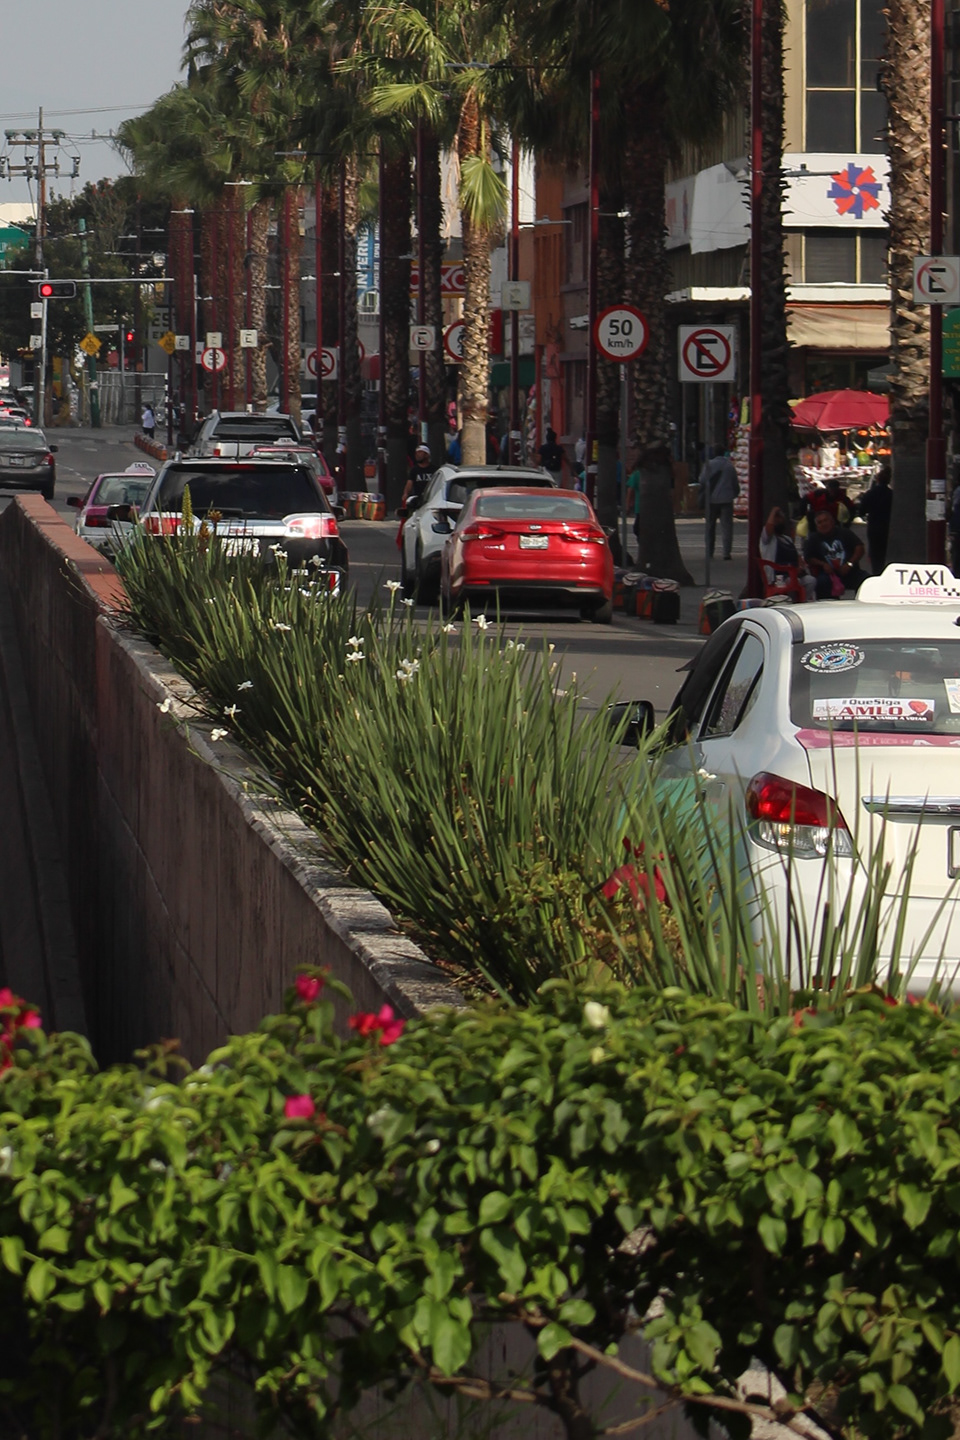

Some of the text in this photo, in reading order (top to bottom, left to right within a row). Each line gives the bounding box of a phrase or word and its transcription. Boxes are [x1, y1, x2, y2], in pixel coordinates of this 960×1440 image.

[609, 319, 633, 336] 50
[607, 338, 634, 348] km/h
[895, 569, 944, 586] TAXI
[909, 587, 940, 596] LIBRE
[841, 698, 901, 706] #QueSiga
[839, 706, 903, 716] AMLO
